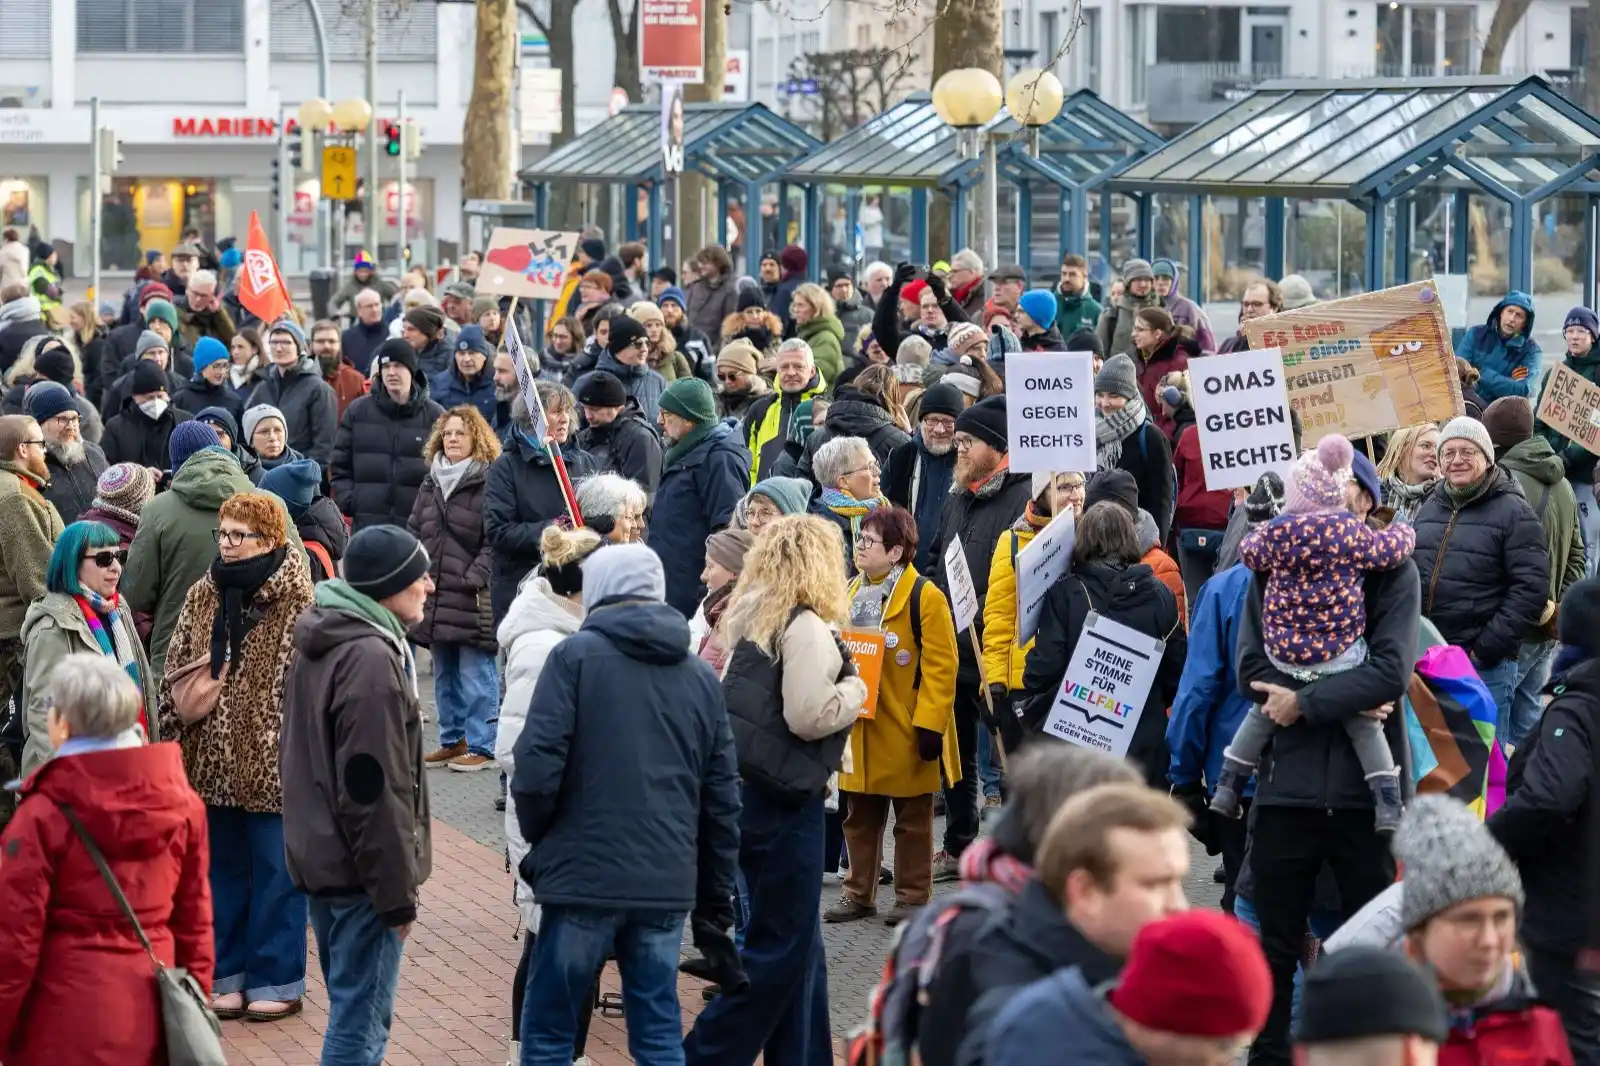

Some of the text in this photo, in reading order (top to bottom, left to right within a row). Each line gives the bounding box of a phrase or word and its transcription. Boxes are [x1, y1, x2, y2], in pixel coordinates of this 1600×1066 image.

[173, 118, 275, 137] MARIEN
[1264, 320, 1346, 349] Es kann
[1282, 338, 1362, 367] ur einen
[1024, 377, 1073, 391] OMAS
[1204, 369, 1276, 395] OMAS
[1286, 363, 1356, 391] raunen
[1553, 369, 1580, 396] ENE
[1290, 384, 1334, 411] ernd
[1549, 388, 1591, 420] MECK DIE
[1022, 406, 1078, 420] GEGEN
[1205, 405, 1285, 432] GEGEN
[1301, 404, 1346, 430] ben!
[1543, 402, 1567, 422] AFD
[1019, 434, 1084, 448] RECHTS
[1209, 443, 1293, 471] RECHTS
[1084, 658, 1133, 686] STIMME
[1093, 647, 1134, 673] MEINE
[1091, 676, 1117, 694] FÜR
[1064, 679, 1134, 719] VIELFALT
[1053, 723, 1112, 752] GEGEN RECHTS
[1077, 725, 1098, 738] Februar
